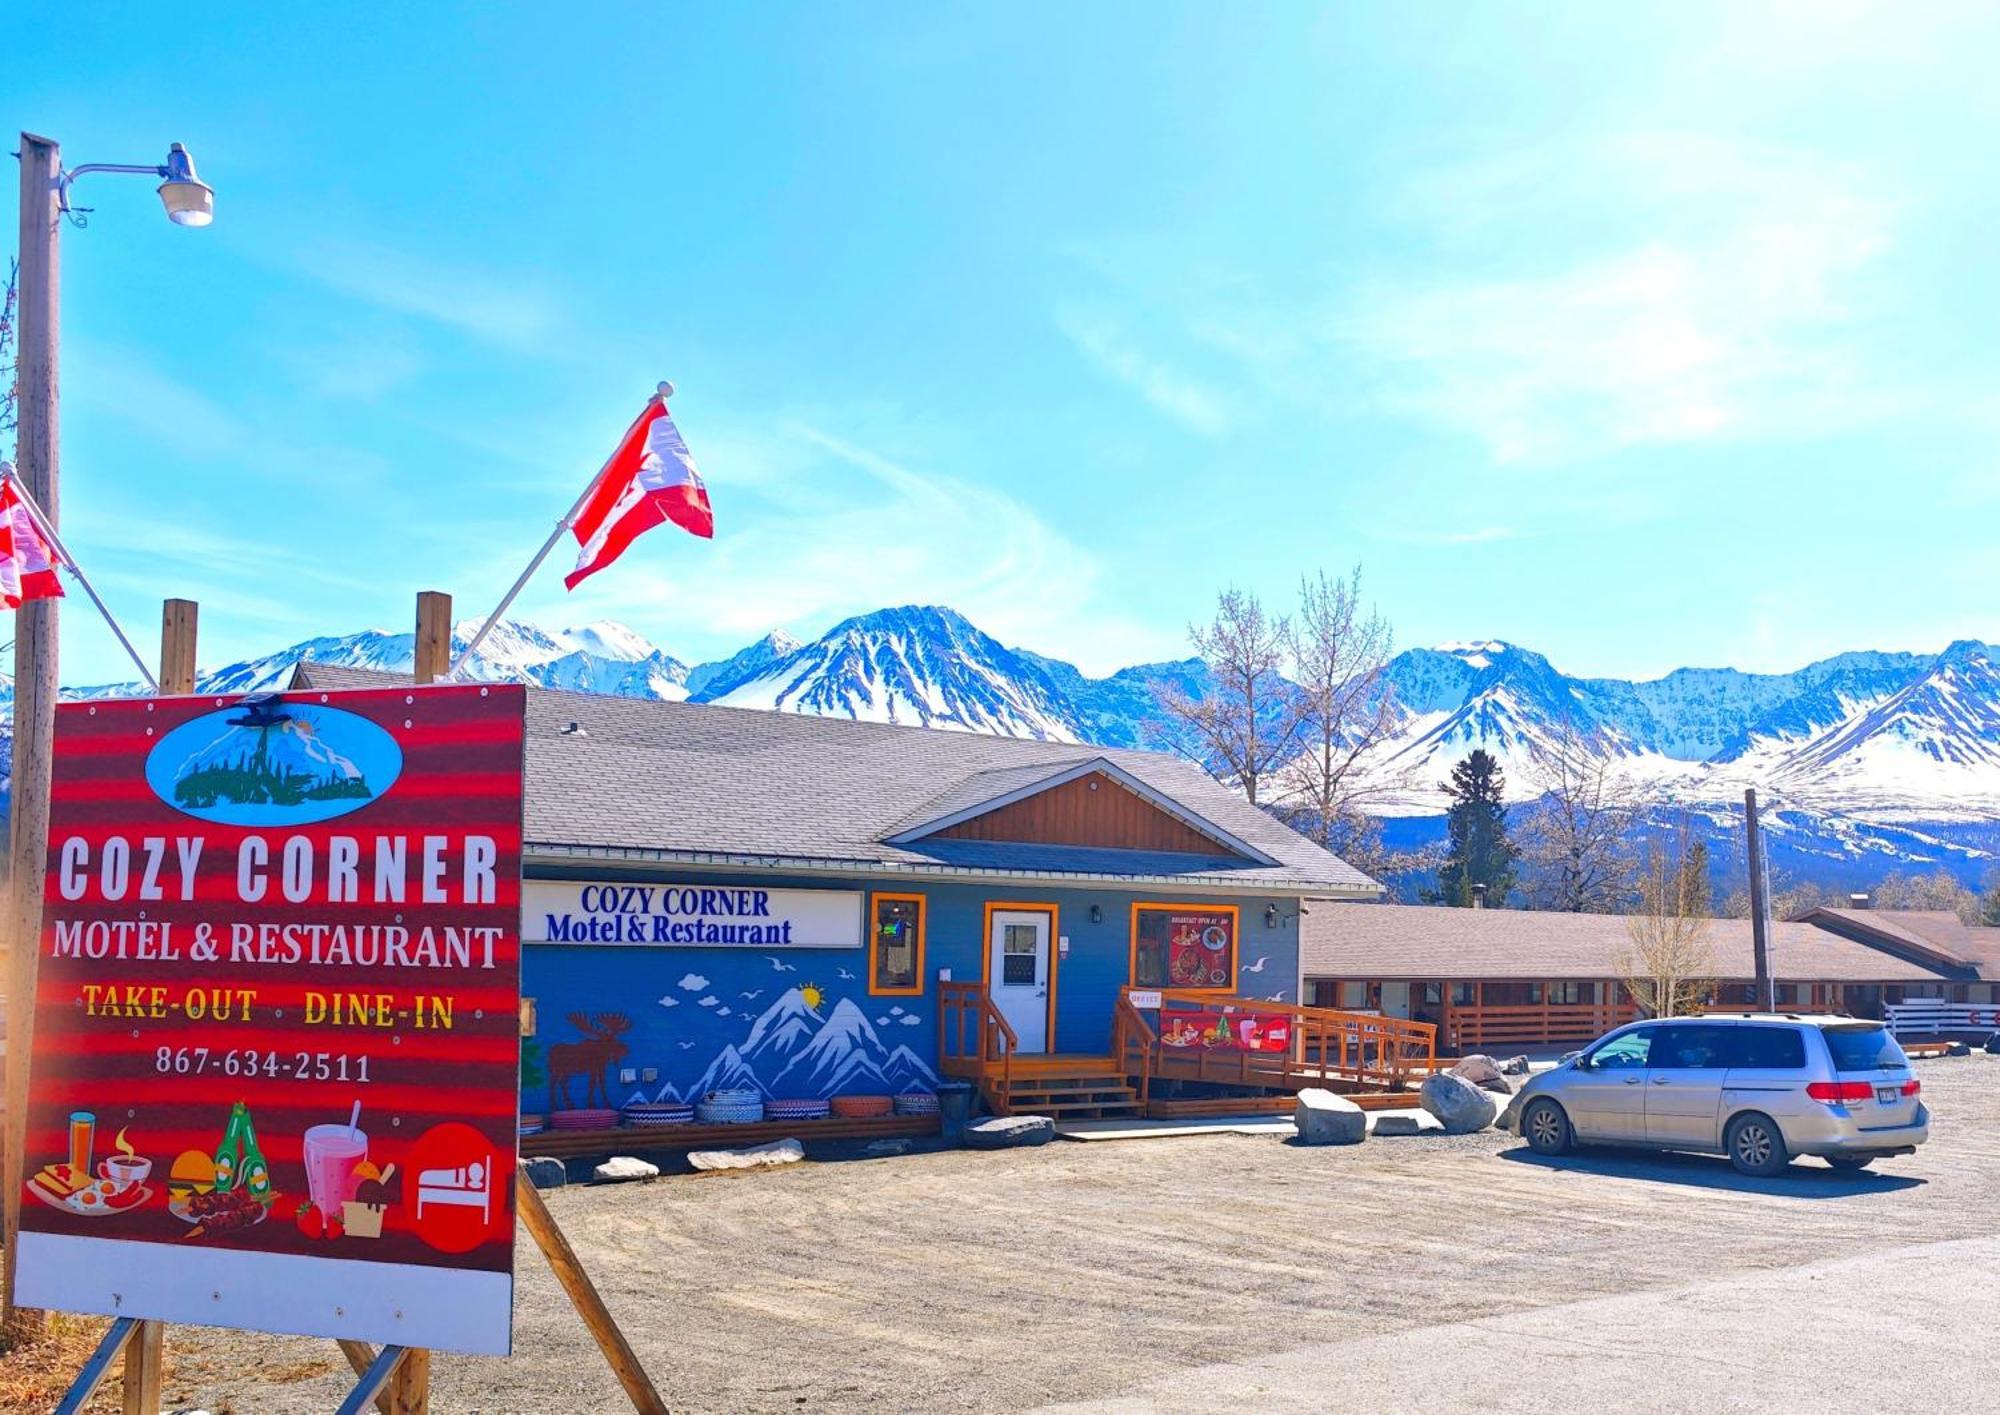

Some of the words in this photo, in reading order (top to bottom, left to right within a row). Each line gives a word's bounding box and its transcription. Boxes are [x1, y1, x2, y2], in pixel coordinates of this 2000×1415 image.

[59, 836, 205, 901] COZY
[236, 835, 496, 904] CORNER
[581, 885, 655, 914] COZY
[663, 888, 769, 917] CORNER
[53, 919, 180, 961] MOTEL
[190, 924, 219, 962] &
[230, 924, 503, 969] RESTAURANT
[546, 913, 623, 943] Motel
[627, 917, 647, 943] &
[652, 916, 792, 945] Restaurant
[83, 985, 257, 1021] TAKE-OUT
[304, 991, 454, 1029] DINE-IN
[155, 1046, 371, 1083] 867-634-2511
